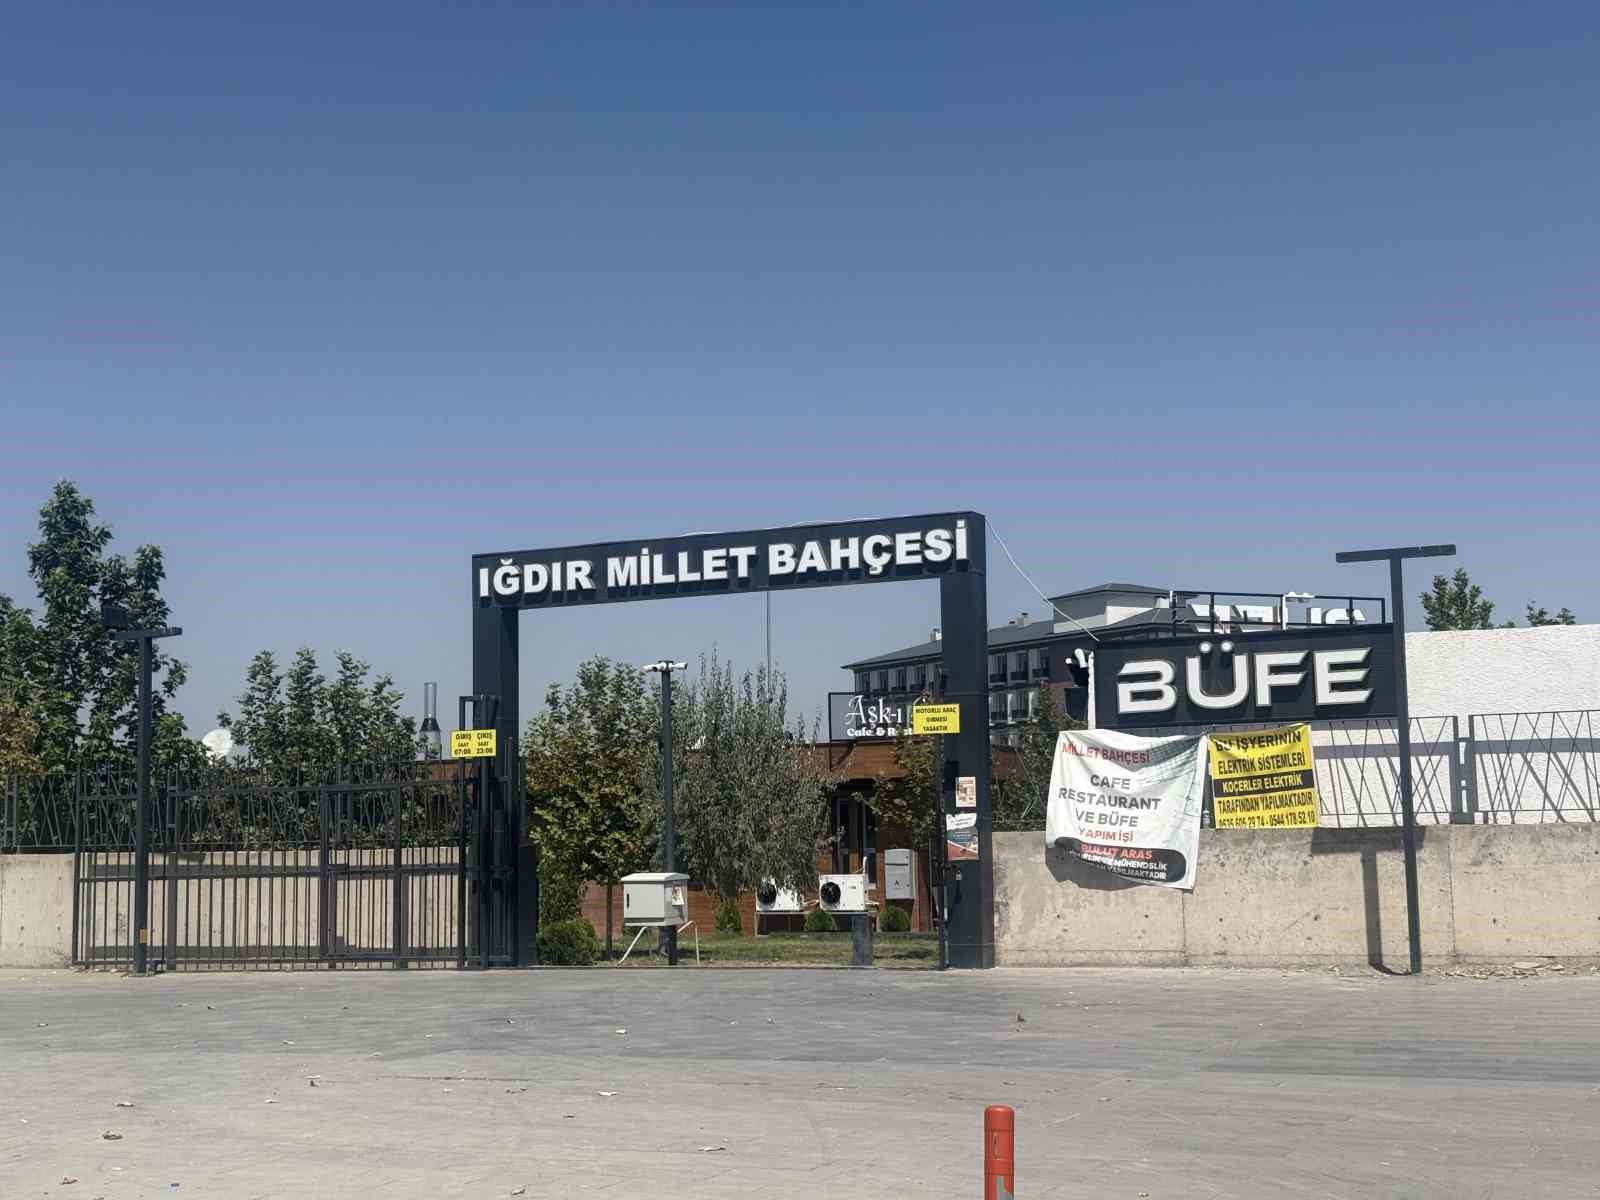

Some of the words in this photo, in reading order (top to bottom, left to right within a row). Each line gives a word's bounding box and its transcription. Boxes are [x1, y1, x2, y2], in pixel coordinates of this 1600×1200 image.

[480, 560, 595, 596] IĞDIR
[607, 547, 757, 587] MİLLET
[768, 520, 968, 575] BAHÇESİ
[1117, 641, 1373, 714] BÜFE
[846, 727, 873, 736] Cafe
[1236, 729, 1302, 753] İŞYERİNİN
[1062, 741, 1099, 758] MİLLET
[1102, 749, 1151, 765] BAHÇESİ
[1217, 757, 1257, 776] ELEKTRİK
[1257, 748, 1306, 771] SİSTEMLERİ
[1090, 774, 1131, 790] CAFE
[1263, 771, 1304, 790] ELEKTRİK
[1058, 787, 1161, 810] RESTAURANT
[1217, 796, 1260, 814] TARAFINDAN
[1260, 791, 1314, 811] YAPILMAKTADIR
[1075, 808, 1094, 823] VE
[1098, 811, 1139, 828] BÜFE
[1078, 827, 1116, 841] YAPIM
[1118, 830, 1134, 843] İŞİ
[1120, 848, 1153, 860] ARAS
